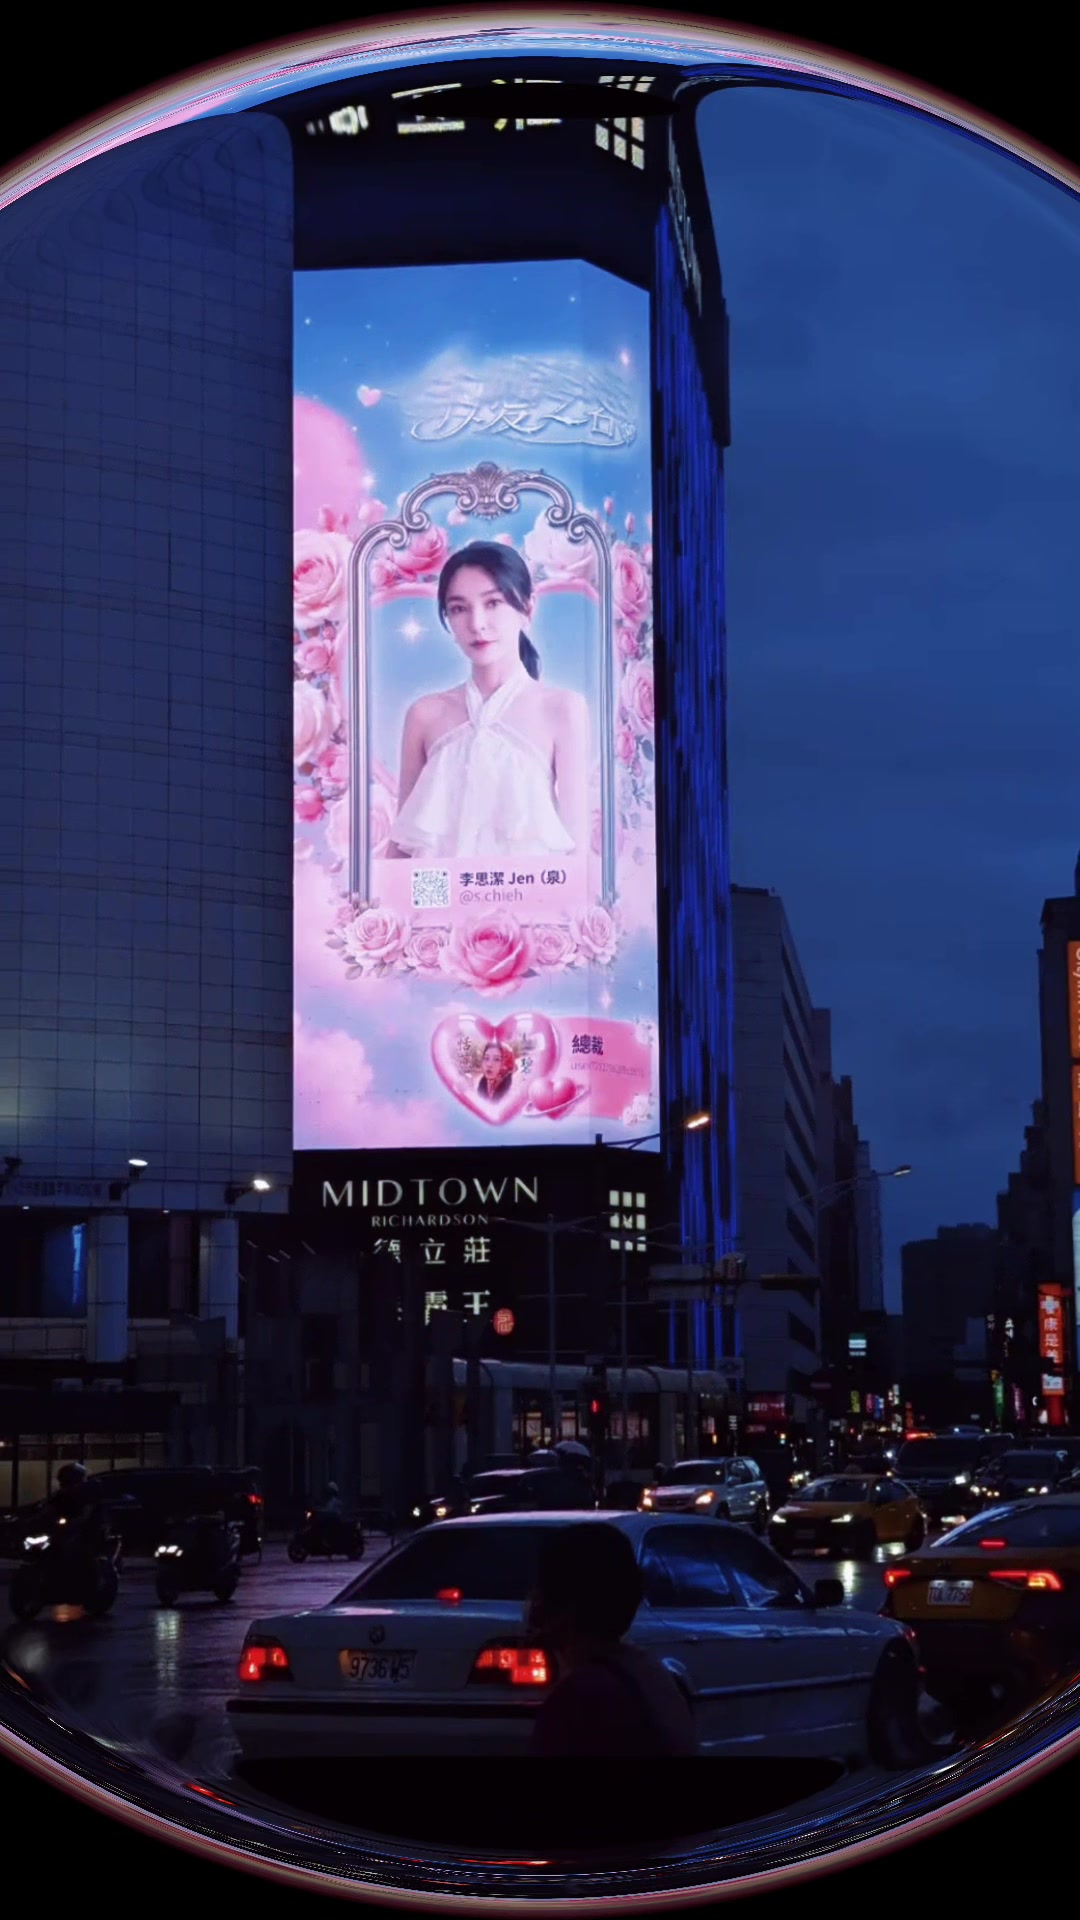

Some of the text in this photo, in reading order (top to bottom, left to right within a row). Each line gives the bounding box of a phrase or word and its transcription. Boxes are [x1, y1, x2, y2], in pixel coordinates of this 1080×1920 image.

[459, 871, 505, 887] 李思潔
[508, 872, 534, 885] Jen
[571, 1034, 604, 1056] 總裁
[322, 1176, 538, 1208] MIDTOWN
[371, 1213, 489, 1228] RICHARDSON
